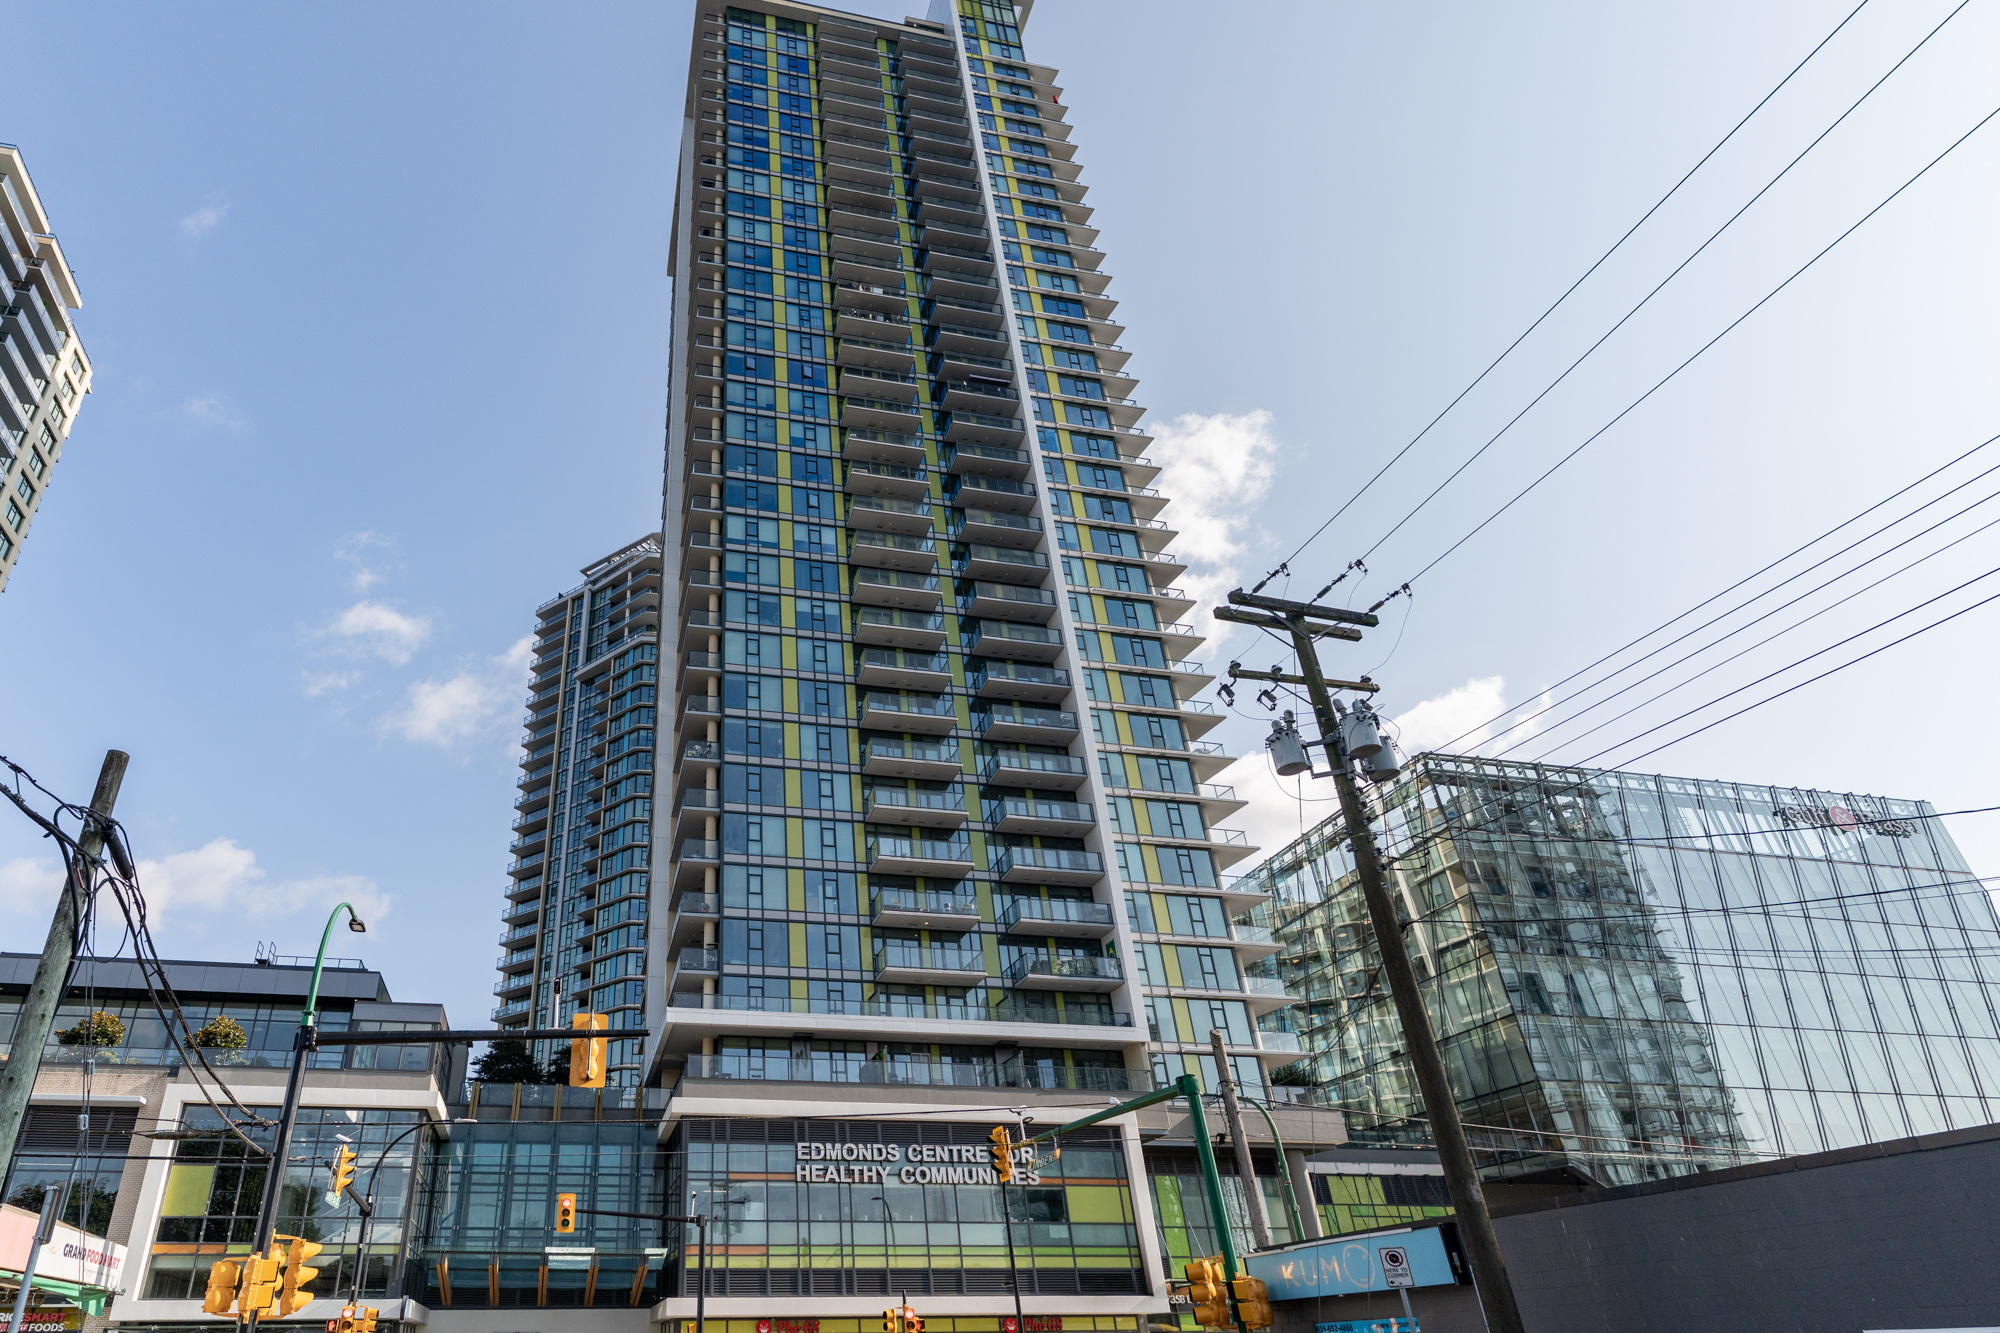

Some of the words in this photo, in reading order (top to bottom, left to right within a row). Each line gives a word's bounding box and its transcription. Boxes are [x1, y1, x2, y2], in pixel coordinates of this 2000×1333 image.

[797, 1142, 900, 1162] EDMONDS
[907, 1144, 989, 1163] CENTRE
[994, 1146, 1034, 1164] OR
[796, 1164, 891, 1183] HEALTHY
[901, 1165, 1041, 1186] COMMUNIIES
[63, 1243, 87, 1261] GRAND
[28, 1323, 65, 1332] FOODS
[803, 1319, 821, 1333] 68
[1047, 1317, 1063, 1332] 68
